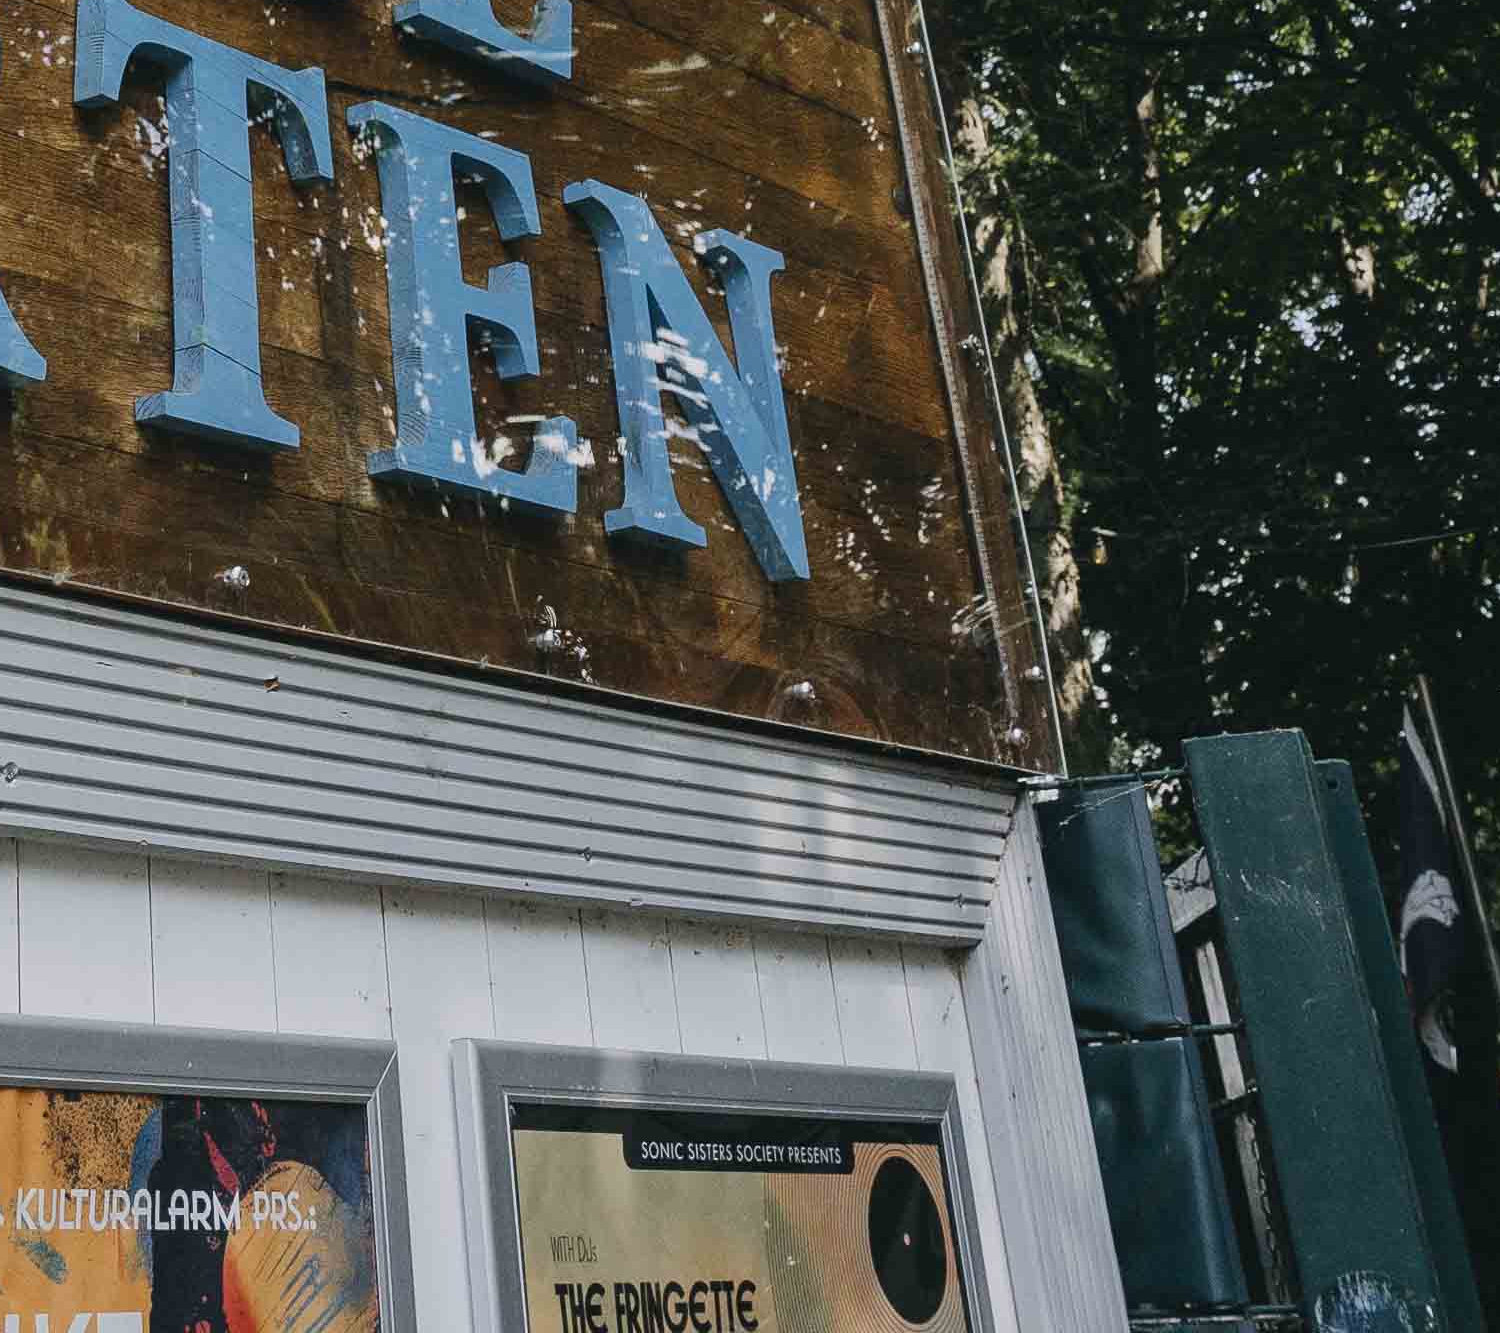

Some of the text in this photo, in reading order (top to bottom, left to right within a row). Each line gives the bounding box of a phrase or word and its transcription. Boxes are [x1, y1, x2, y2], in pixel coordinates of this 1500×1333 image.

[641, 1141, 843, 1165] SONIC SISTERS SOCIETY PRESENTS
[16, 1188, 241, 1231] KULTURALARM
[550, 1236, 575, 1263] WITH
[554, 1280, 760, 1333] THE FRINGETTE
